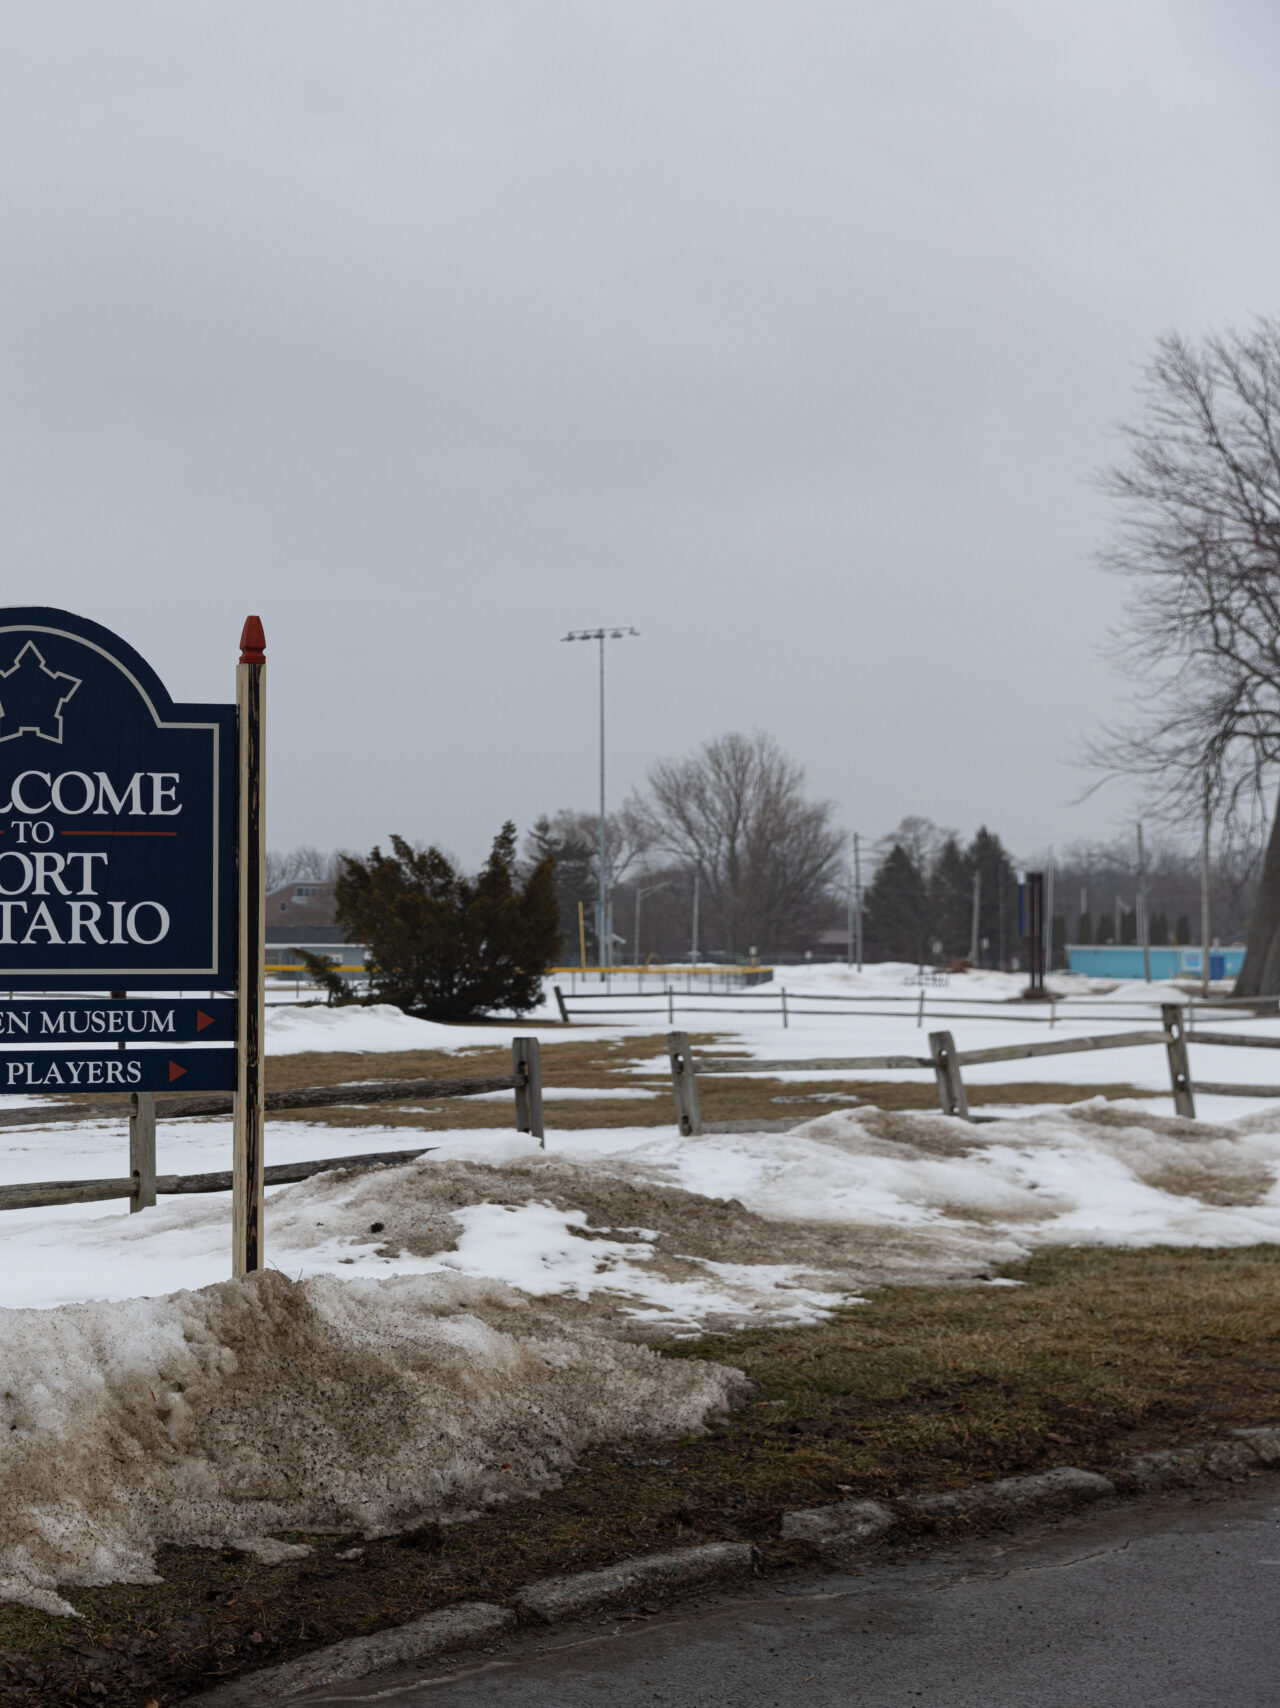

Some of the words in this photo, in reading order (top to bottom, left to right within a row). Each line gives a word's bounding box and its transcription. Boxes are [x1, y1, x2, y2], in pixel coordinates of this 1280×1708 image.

[10, 820, 55, 844] TO
[39, 1009, 176, 1034] MUSEUM
[6, 1060, 142, 1085] PLAYERS
